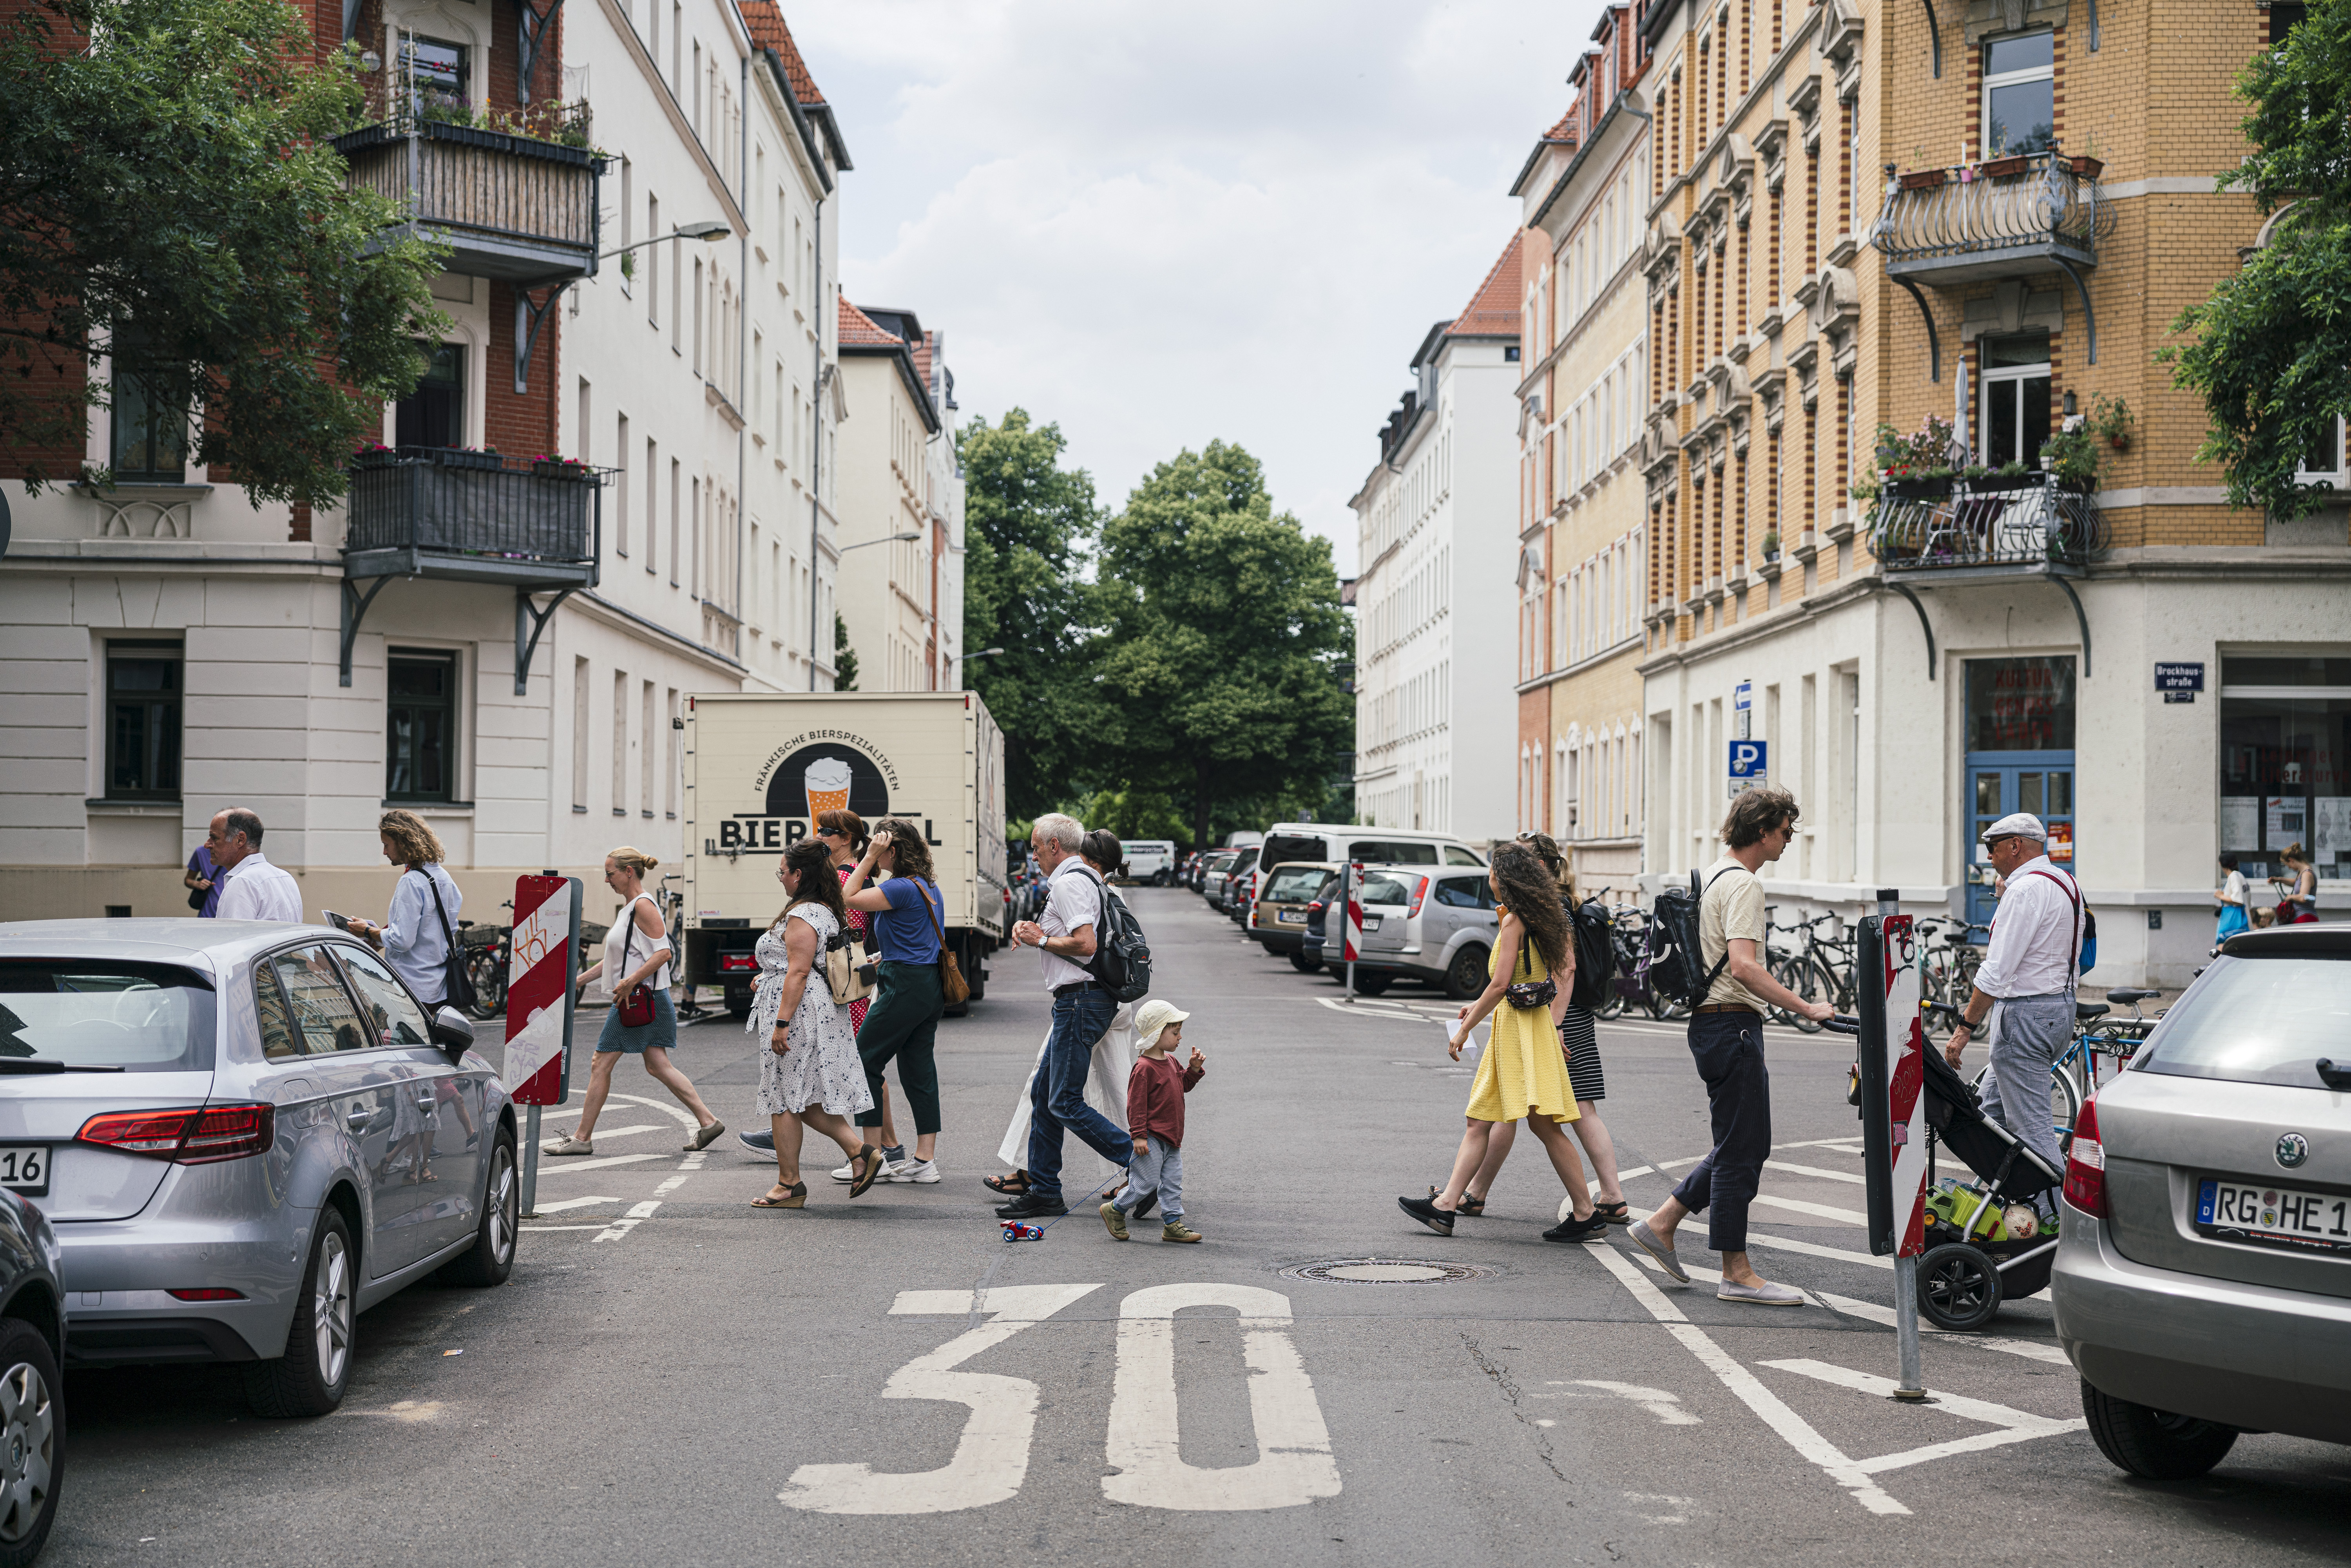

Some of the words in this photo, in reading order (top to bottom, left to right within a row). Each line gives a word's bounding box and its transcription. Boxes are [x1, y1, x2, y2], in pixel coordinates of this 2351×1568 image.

[1996, 668, 2052, 688] KULTUR
[2166, 677, 2192, 686] straße
[1995, 697, 2053, 717] GENUSS
[1996, 721, 2053, 740] LADEN
[755, 734, 806, 791] FRÄNKISCHE
[809, 730, 900, 791] BIERSPEZIALITÄTEN
[1737, 745, 1759, 763] P
[2261, 747, 2334, 766] Leipziger
[721, 821, 807, 847] BIER
[1893, 1060, 1915, 1095] SNOW
[1, 1152, 40, 1182] 16
[2202, 1206, 2210, 1216] D
[2217, 1187, 2258, 1224] RG
[2279, 1194, 2324, 1233] HE
[2329, 1201, 2351, 1237] 1
[775, 1282, 1343, 1515] 30
